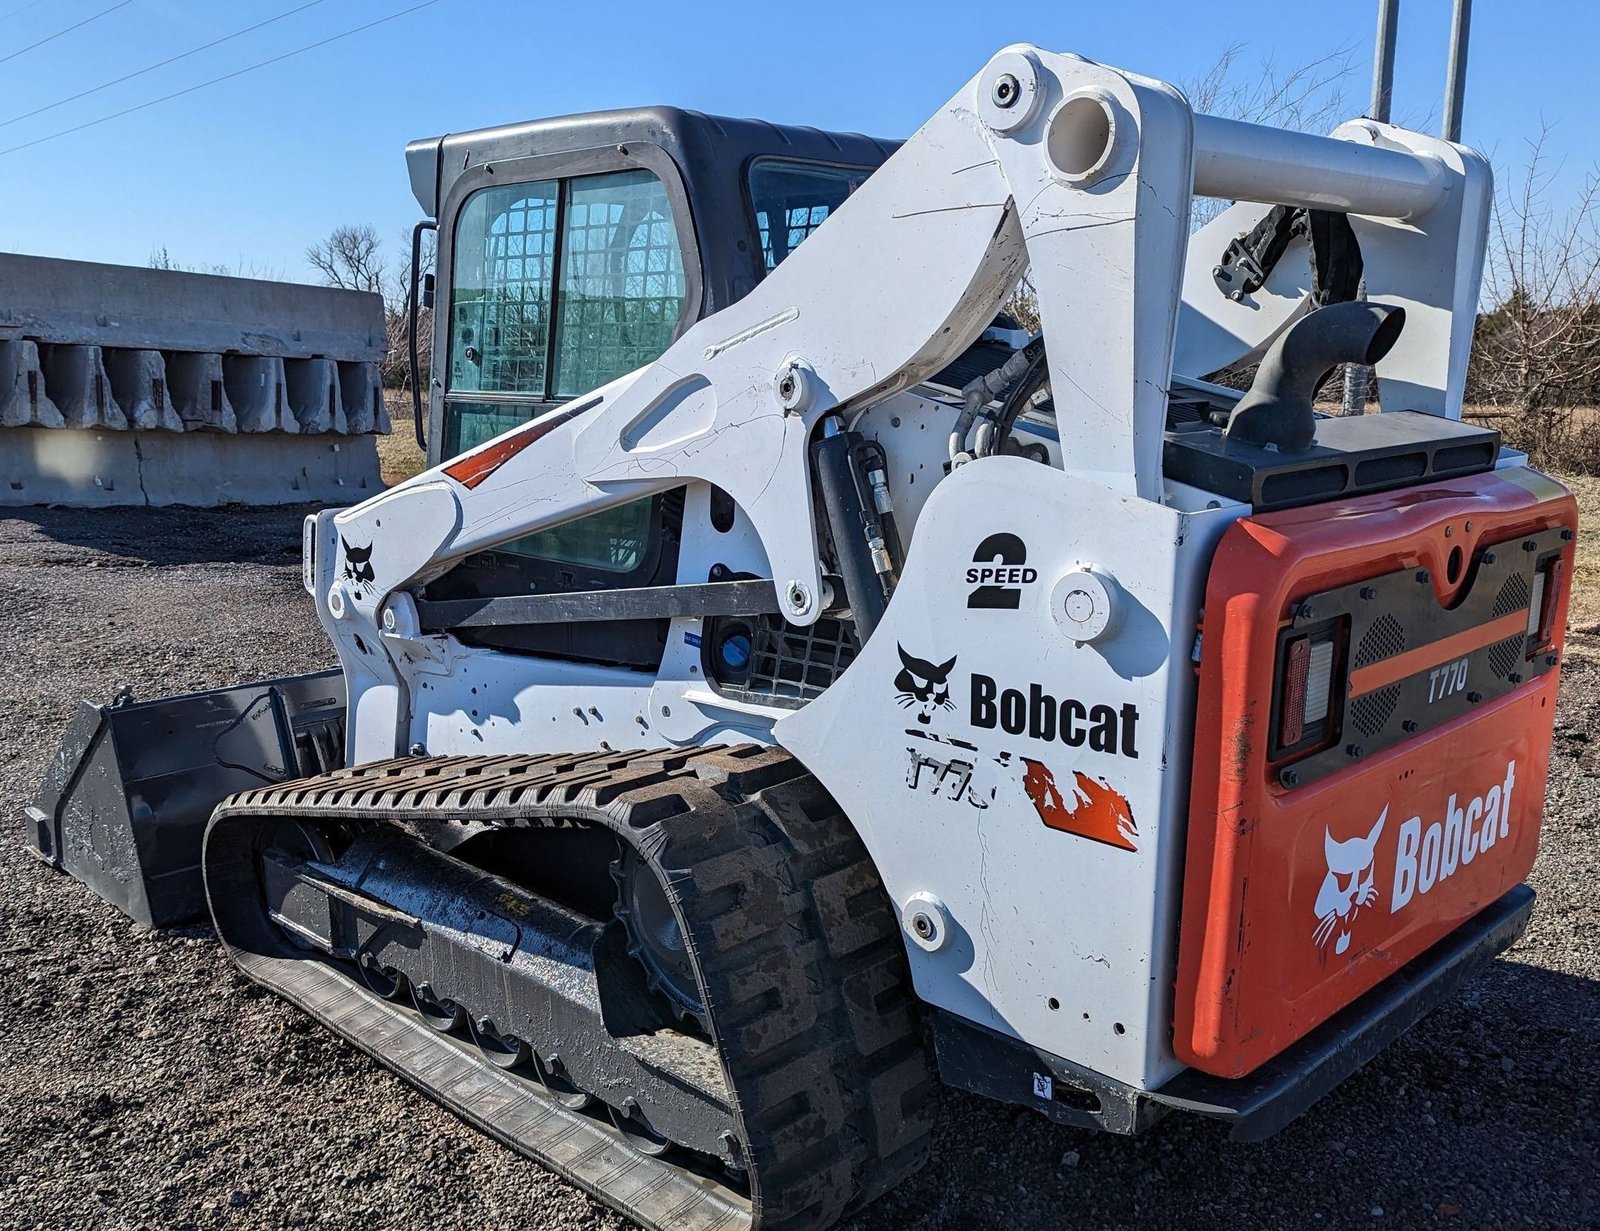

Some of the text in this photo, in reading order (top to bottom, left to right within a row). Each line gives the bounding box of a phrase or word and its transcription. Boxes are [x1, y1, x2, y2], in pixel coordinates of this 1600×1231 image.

[965, 568, 1038, 584] SPEED
[967, 532, 1027, 610] 2
[970, 673, 1139, 759] Bobcat
[1428, 658, 1469, 704] T770
[1391, 759, 1516, 915] Bobcat
